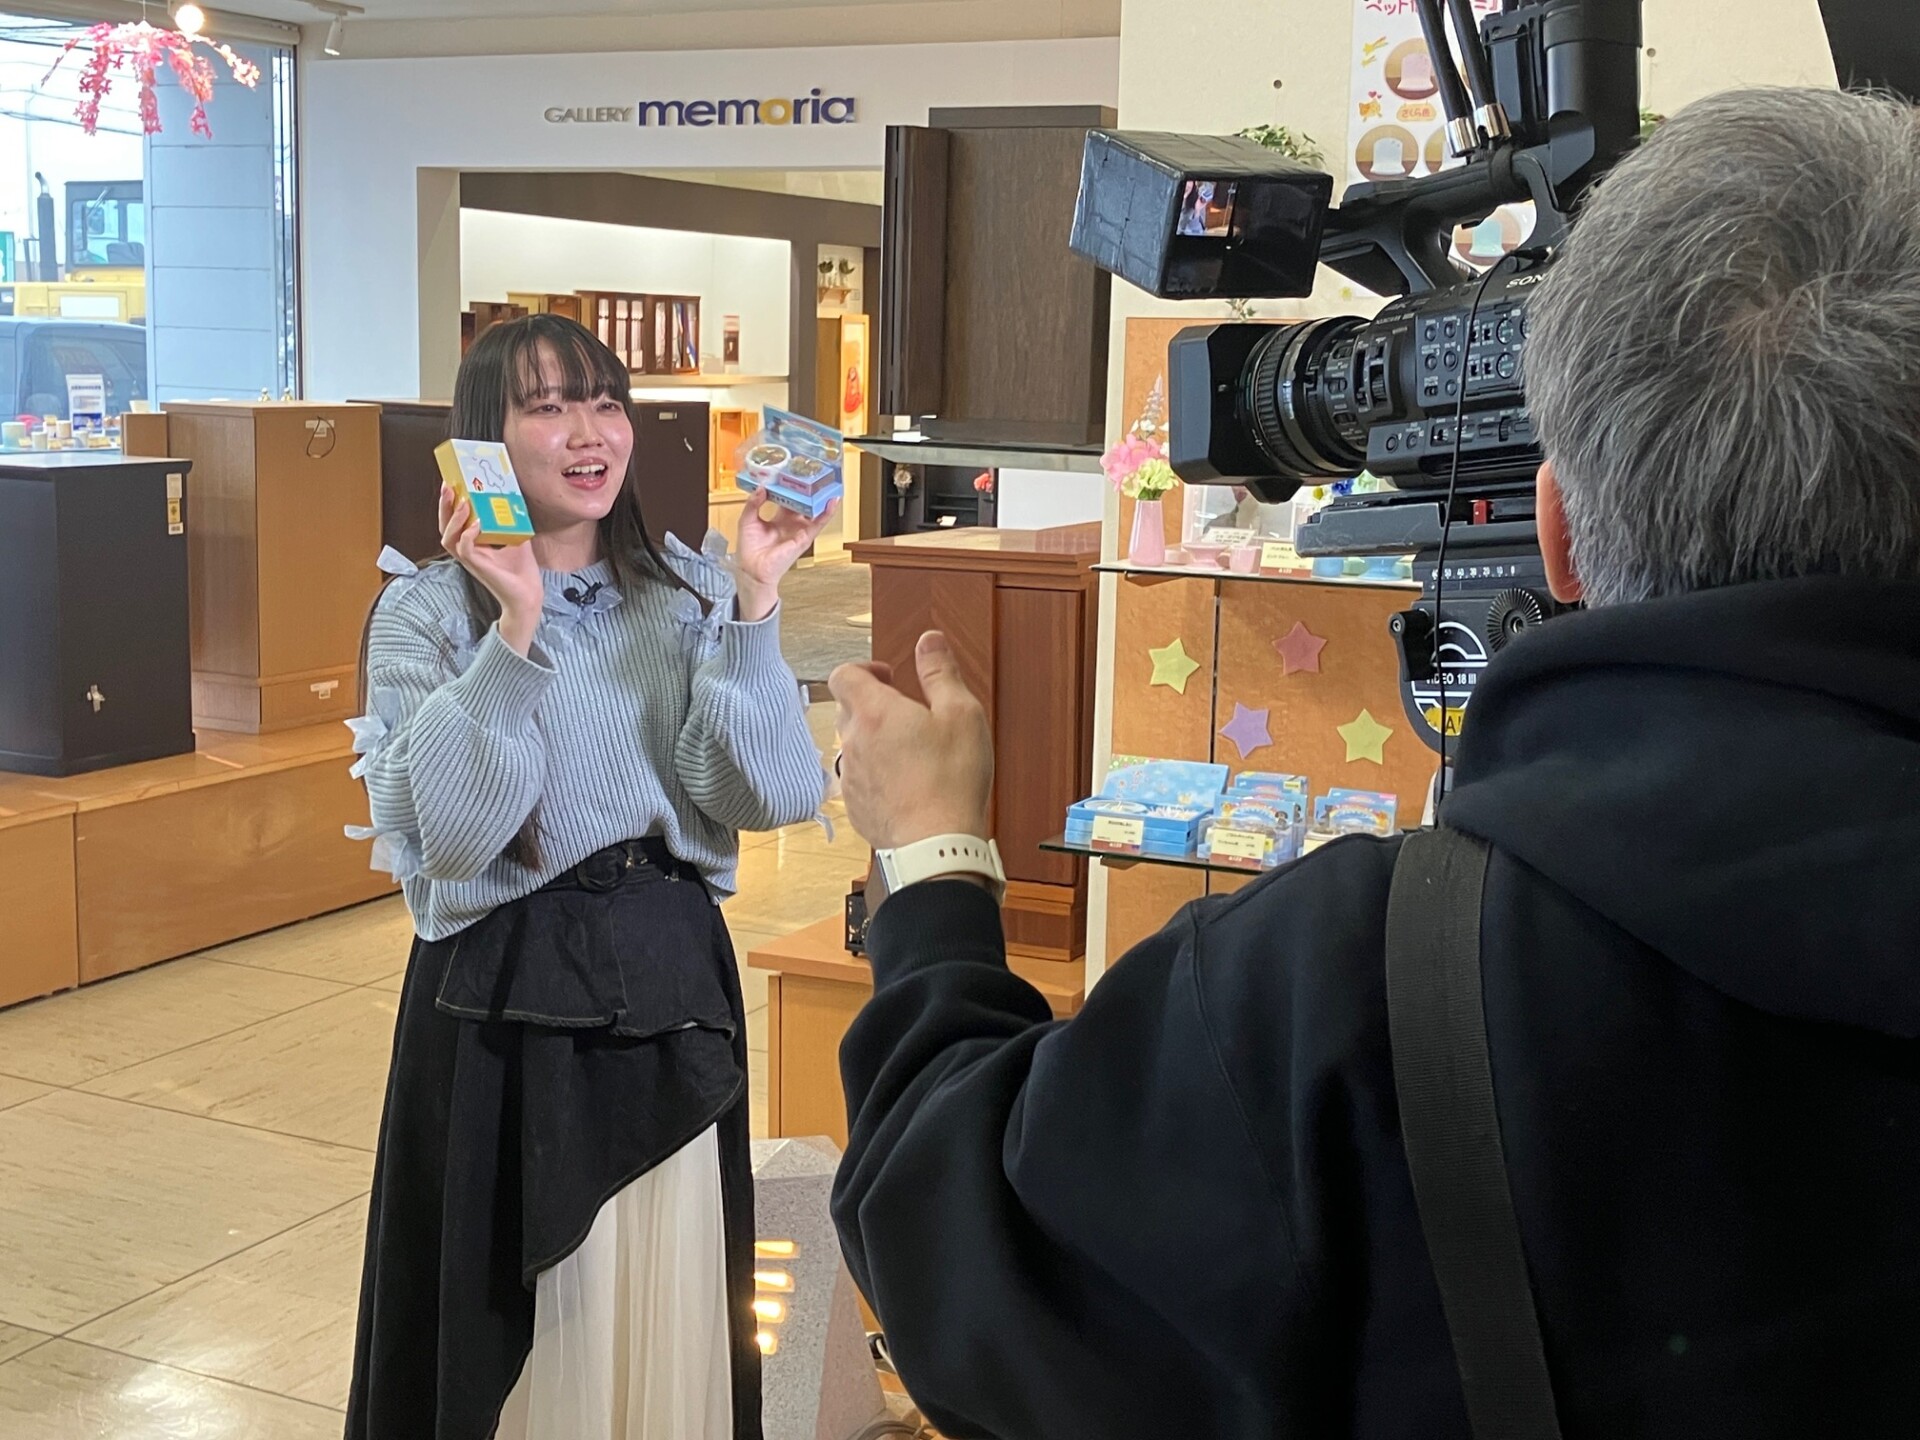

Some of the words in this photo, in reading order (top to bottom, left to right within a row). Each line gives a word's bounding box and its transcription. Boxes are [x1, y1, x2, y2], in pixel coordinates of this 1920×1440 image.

[544, 106, 633, 123] GALLERY
[638, 88, 855, 127] memoria
[1505, 273, 1547, 288] SON
[1457, 673, 1467, 685] 18
